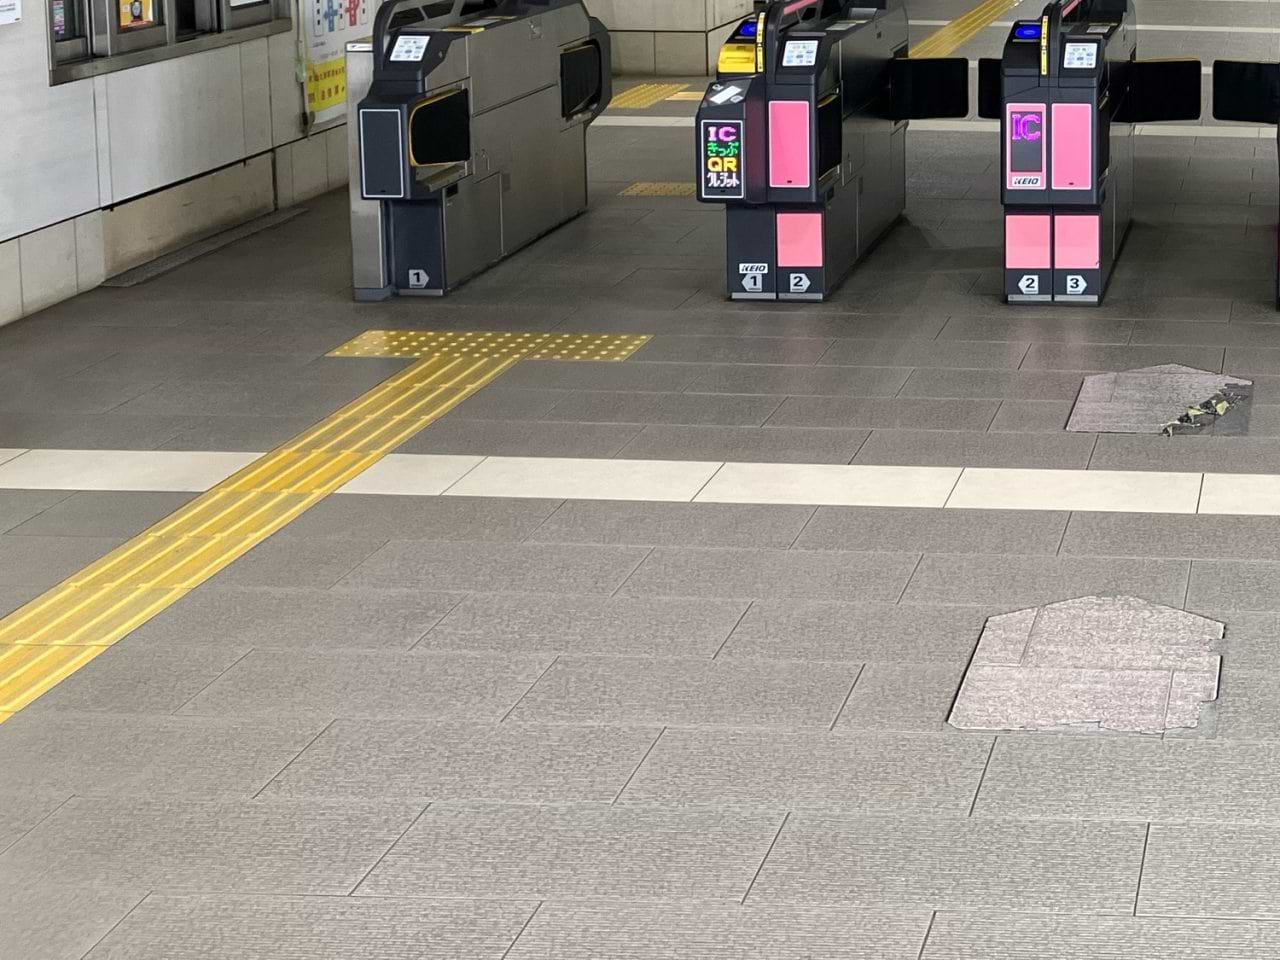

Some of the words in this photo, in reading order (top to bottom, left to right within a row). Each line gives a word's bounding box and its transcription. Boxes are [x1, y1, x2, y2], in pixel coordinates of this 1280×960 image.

[1011, 113, 1041, 141] IC
[707, 126, 737, 142] IC
[707, 142, 740, 156] きっぷ
[707, 156, 738, 172] QR
[1014, 177, 1039, 185] KEIO
[741, 264, 767, 272] KEIO
[413, 271, 421, 282] 1
[749, 276, 758, 287] 1
[792, 276, 803, 287] 2
[1025, 277, 1035, 288] 2
[1070, 278, 1080, 288] 3
